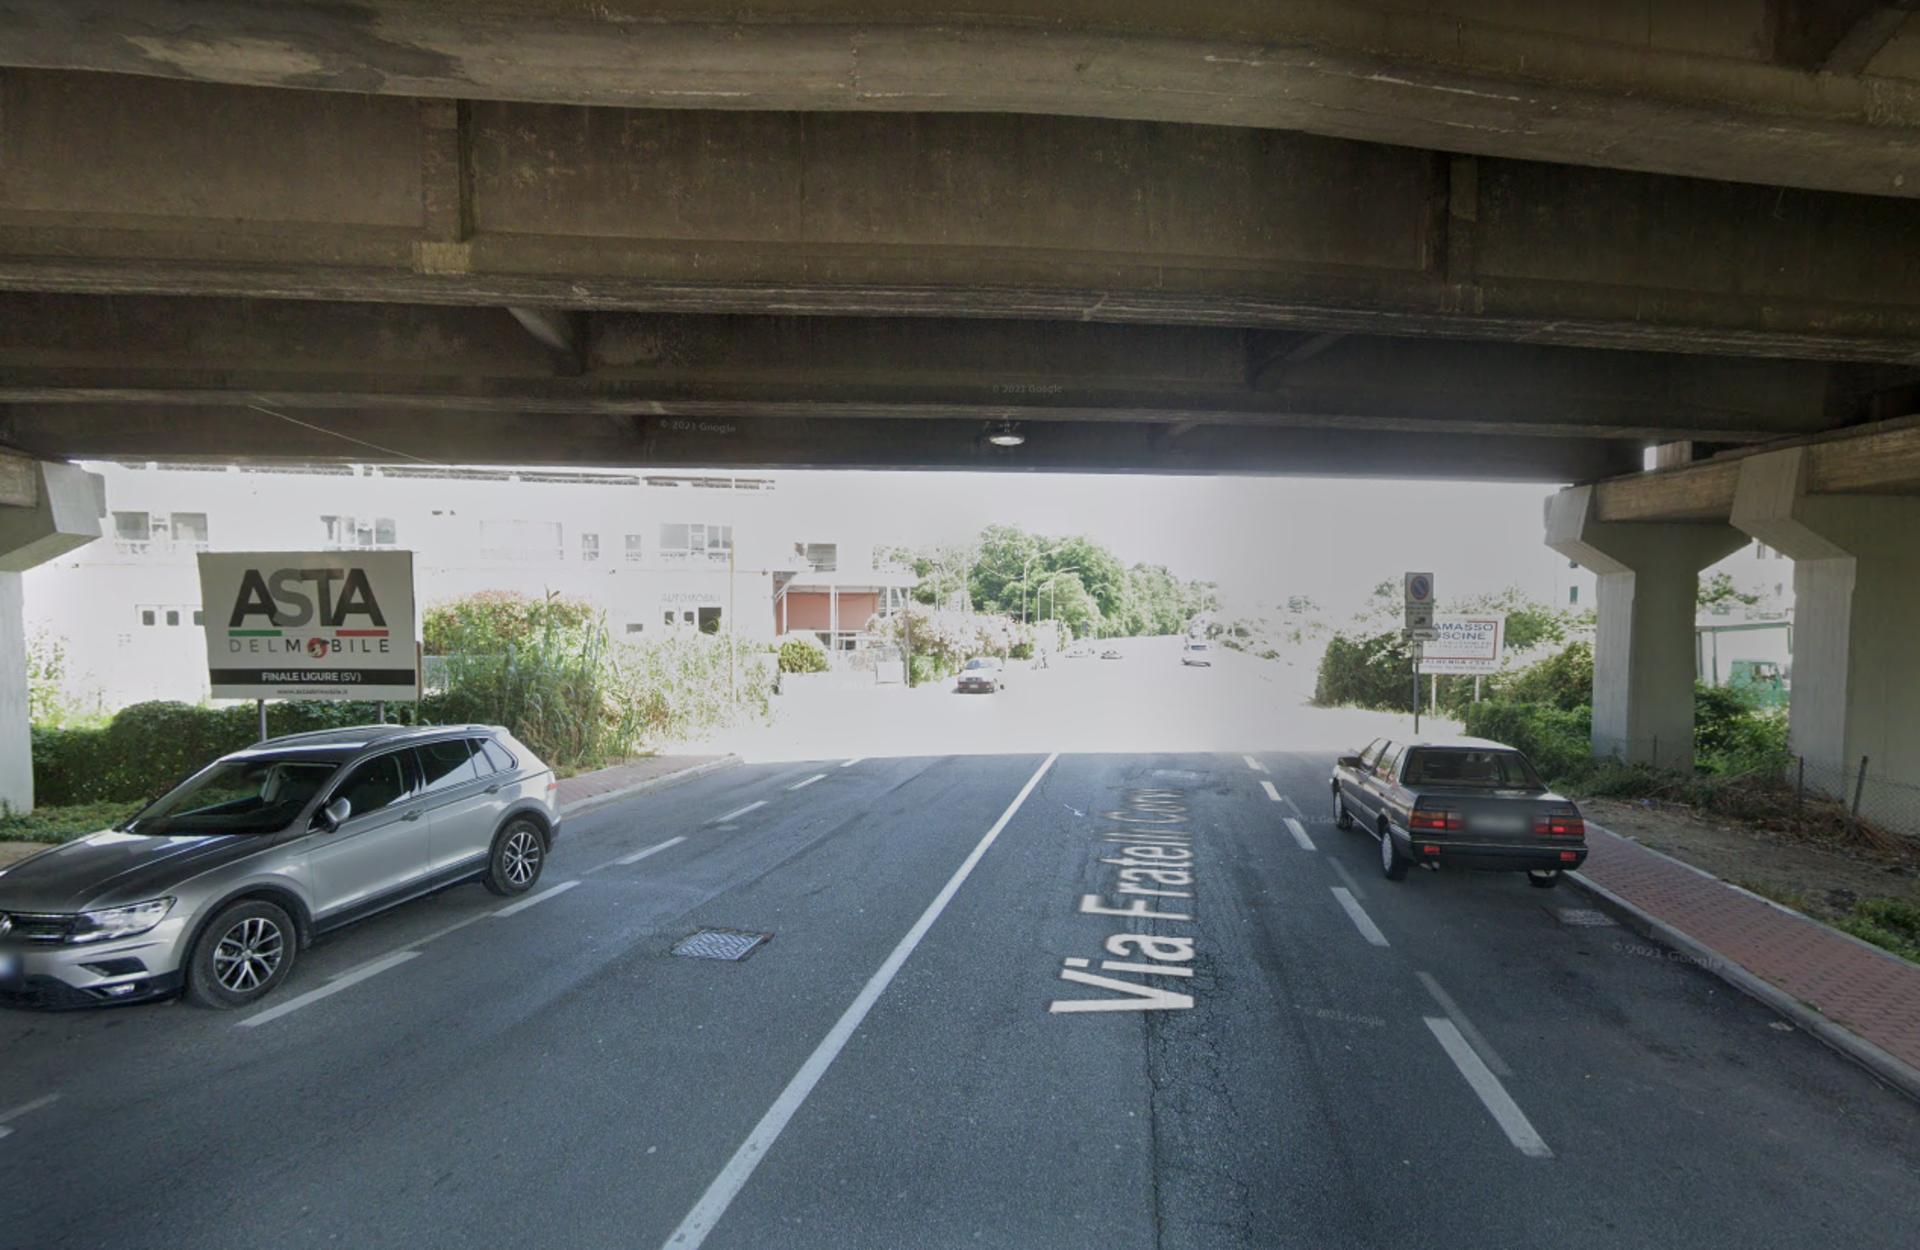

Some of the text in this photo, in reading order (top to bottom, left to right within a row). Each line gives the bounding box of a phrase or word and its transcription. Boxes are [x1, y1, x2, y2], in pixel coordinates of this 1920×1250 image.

[228, 568, 387, 627] ASTA
[1432, 623, 1494, 632] AMASSO
[1439, 632, 1486, 640] SCINE
[229, 637, 390, 659] DELMOBILE
[262, 671, 362, 683] FINALE LIGURE (SV)
[1079, 829, 1194, 921] Fratelli
[1049, 932, 1195, 1013] Via
